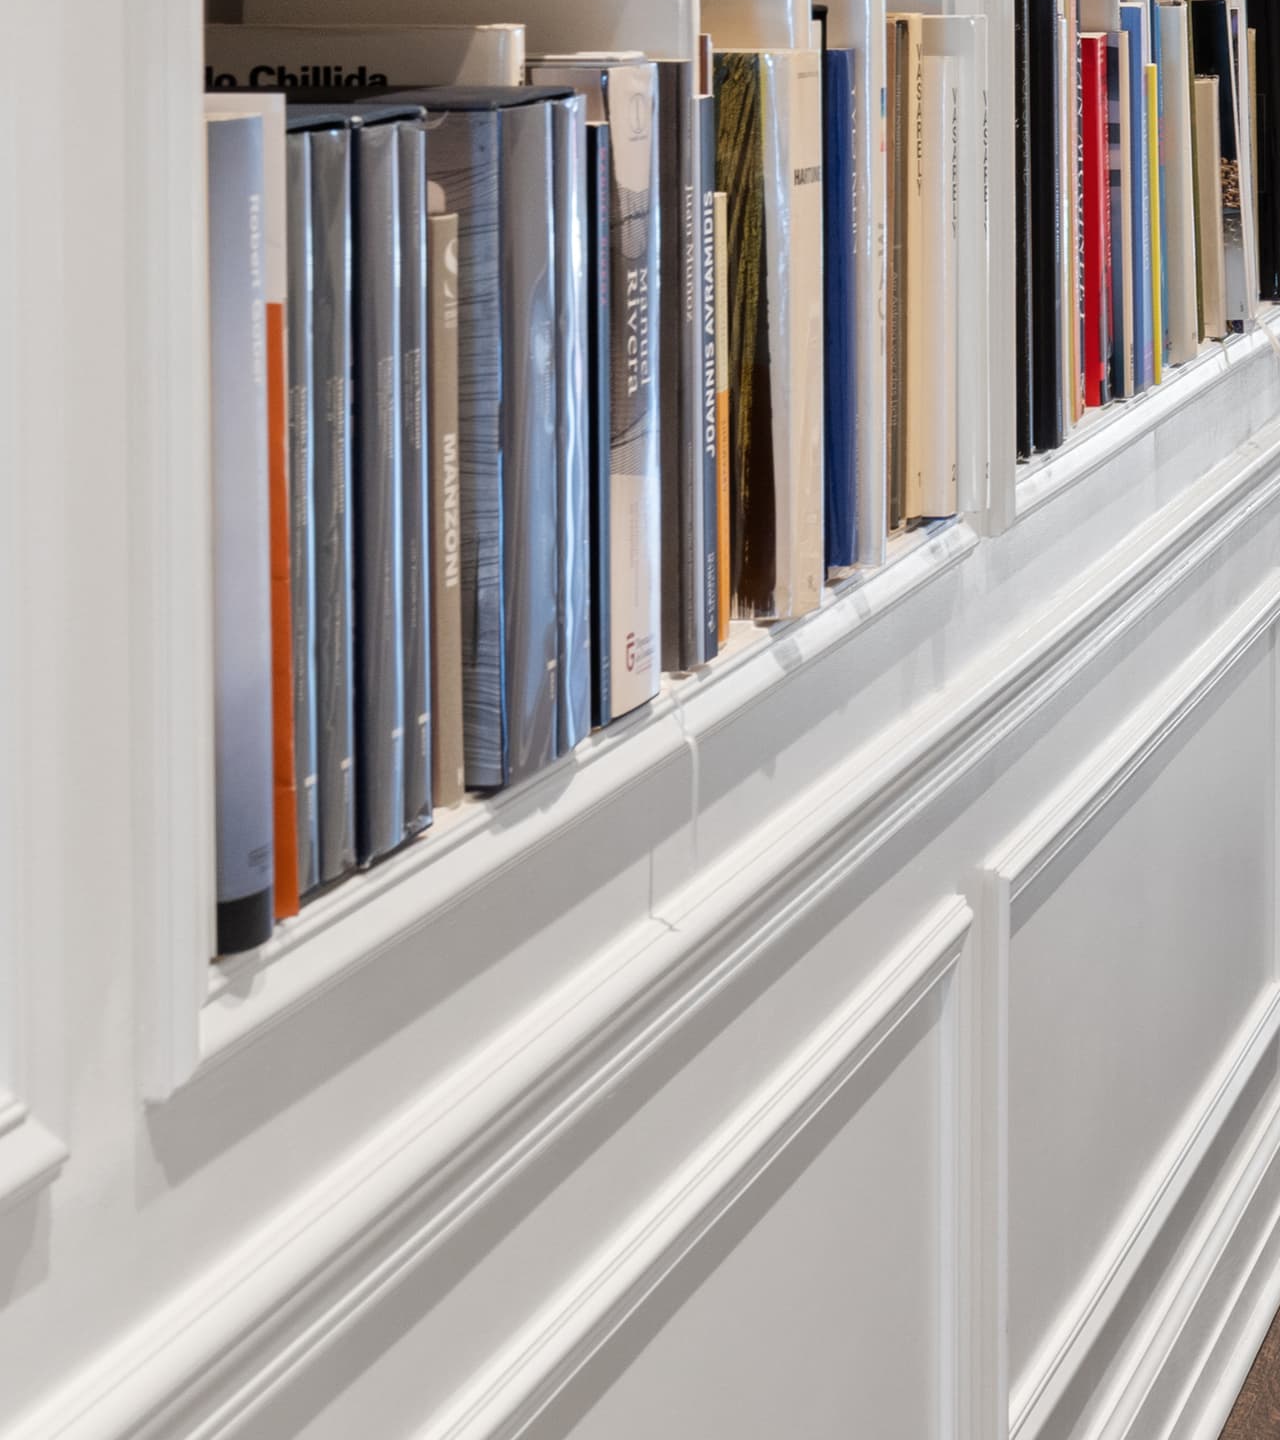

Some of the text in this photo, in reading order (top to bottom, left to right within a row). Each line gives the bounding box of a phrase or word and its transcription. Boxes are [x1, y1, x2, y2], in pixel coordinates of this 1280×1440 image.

[249, 65, 389, 88] Chillida
[684, 185, 694, 238] Juan
[951, 87, 959, 240] VASARELY
[248, 195, 261, 288] Robert
[626, 270, 640, 396] Rivera
[639, 268, 651, 385] Manuel
[704, 191, 716, 458] JOANNIS AVRAMIDIS
[443, 433, 458, 589] MANZONI
